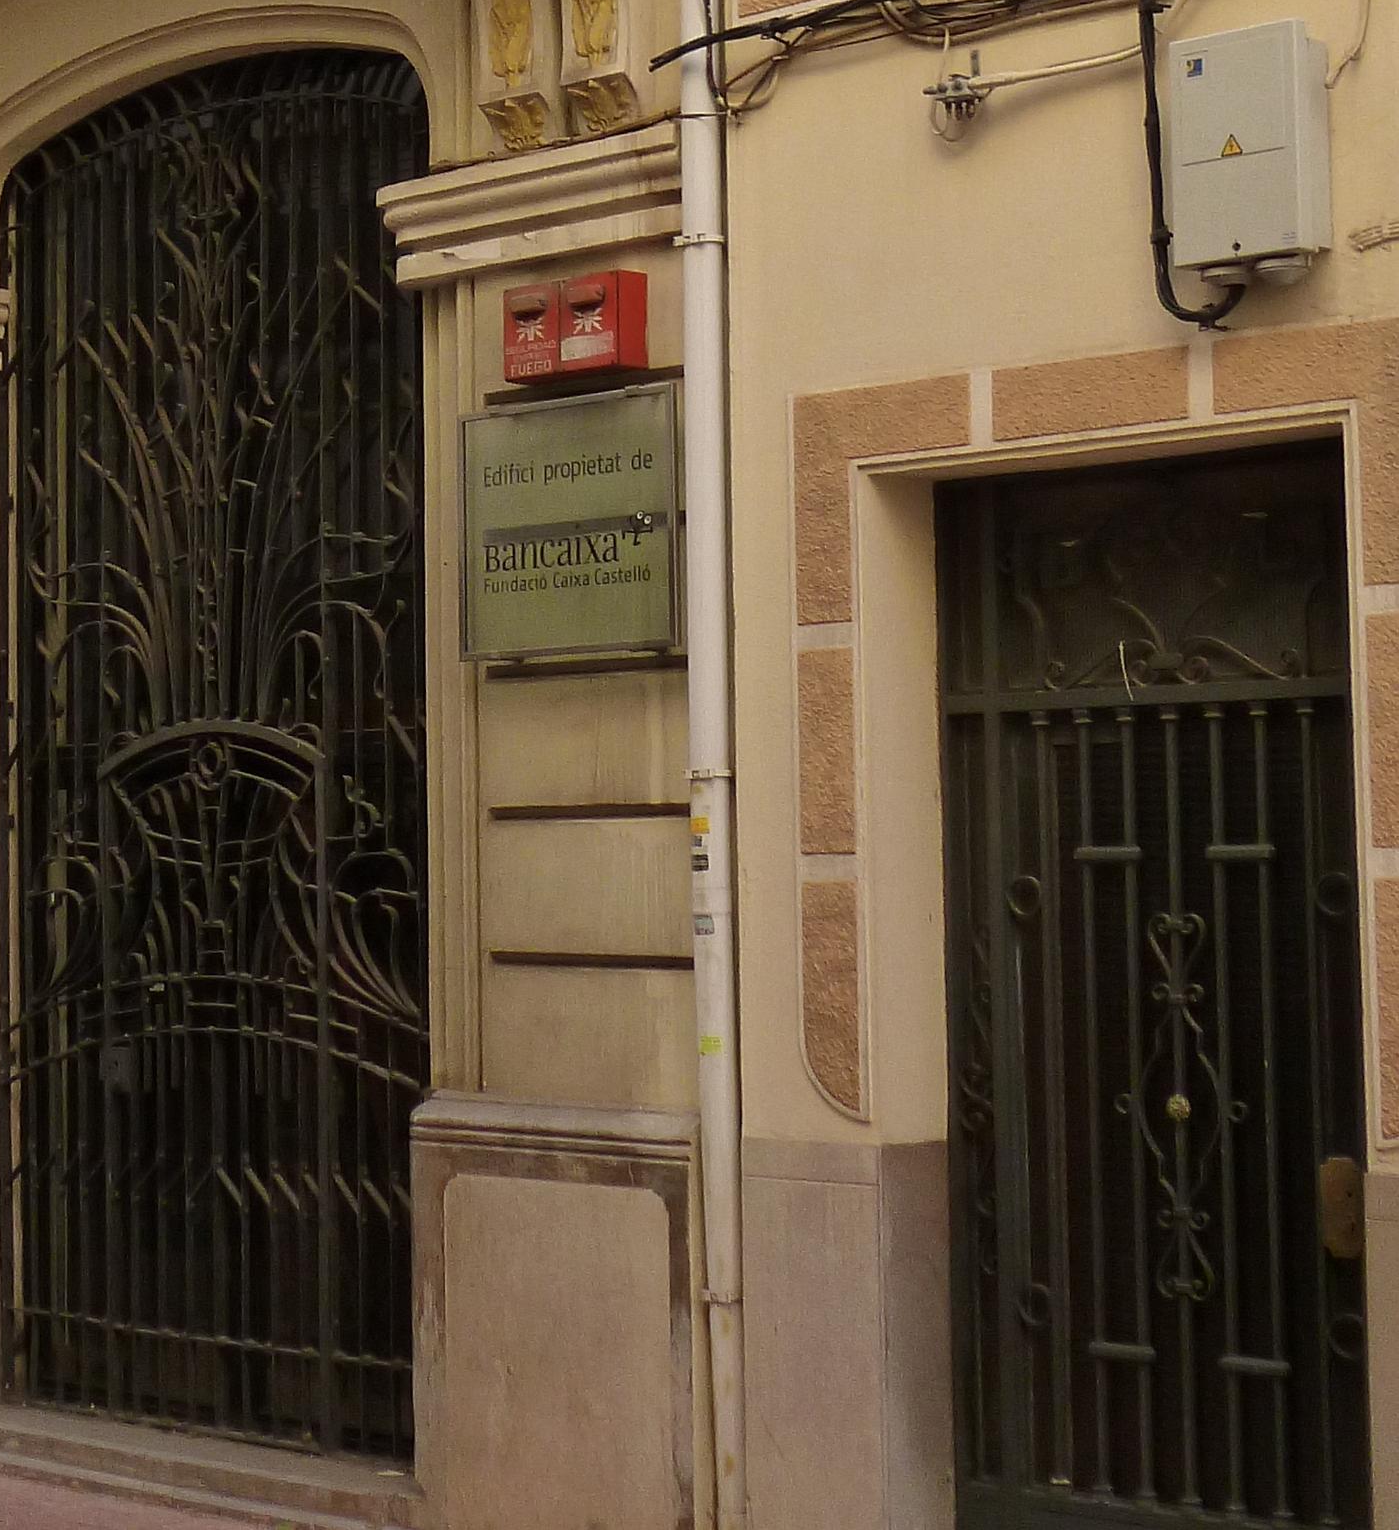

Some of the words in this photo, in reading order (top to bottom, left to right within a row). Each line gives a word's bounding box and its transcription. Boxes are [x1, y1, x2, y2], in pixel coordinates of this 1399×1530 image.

[510, 359, 552, 378] FUEGO
[484, 460, 535, 488] Edifici
[543, 452, 622, 486] propietat
[630, 448, 654, 470] de
[483, 531, 620, 573] Bancaixa
[483, 575, 548, 595] Fundació
[552, 569, 590, 588] Caixa
[594, 563, 652, 586] Castelló
